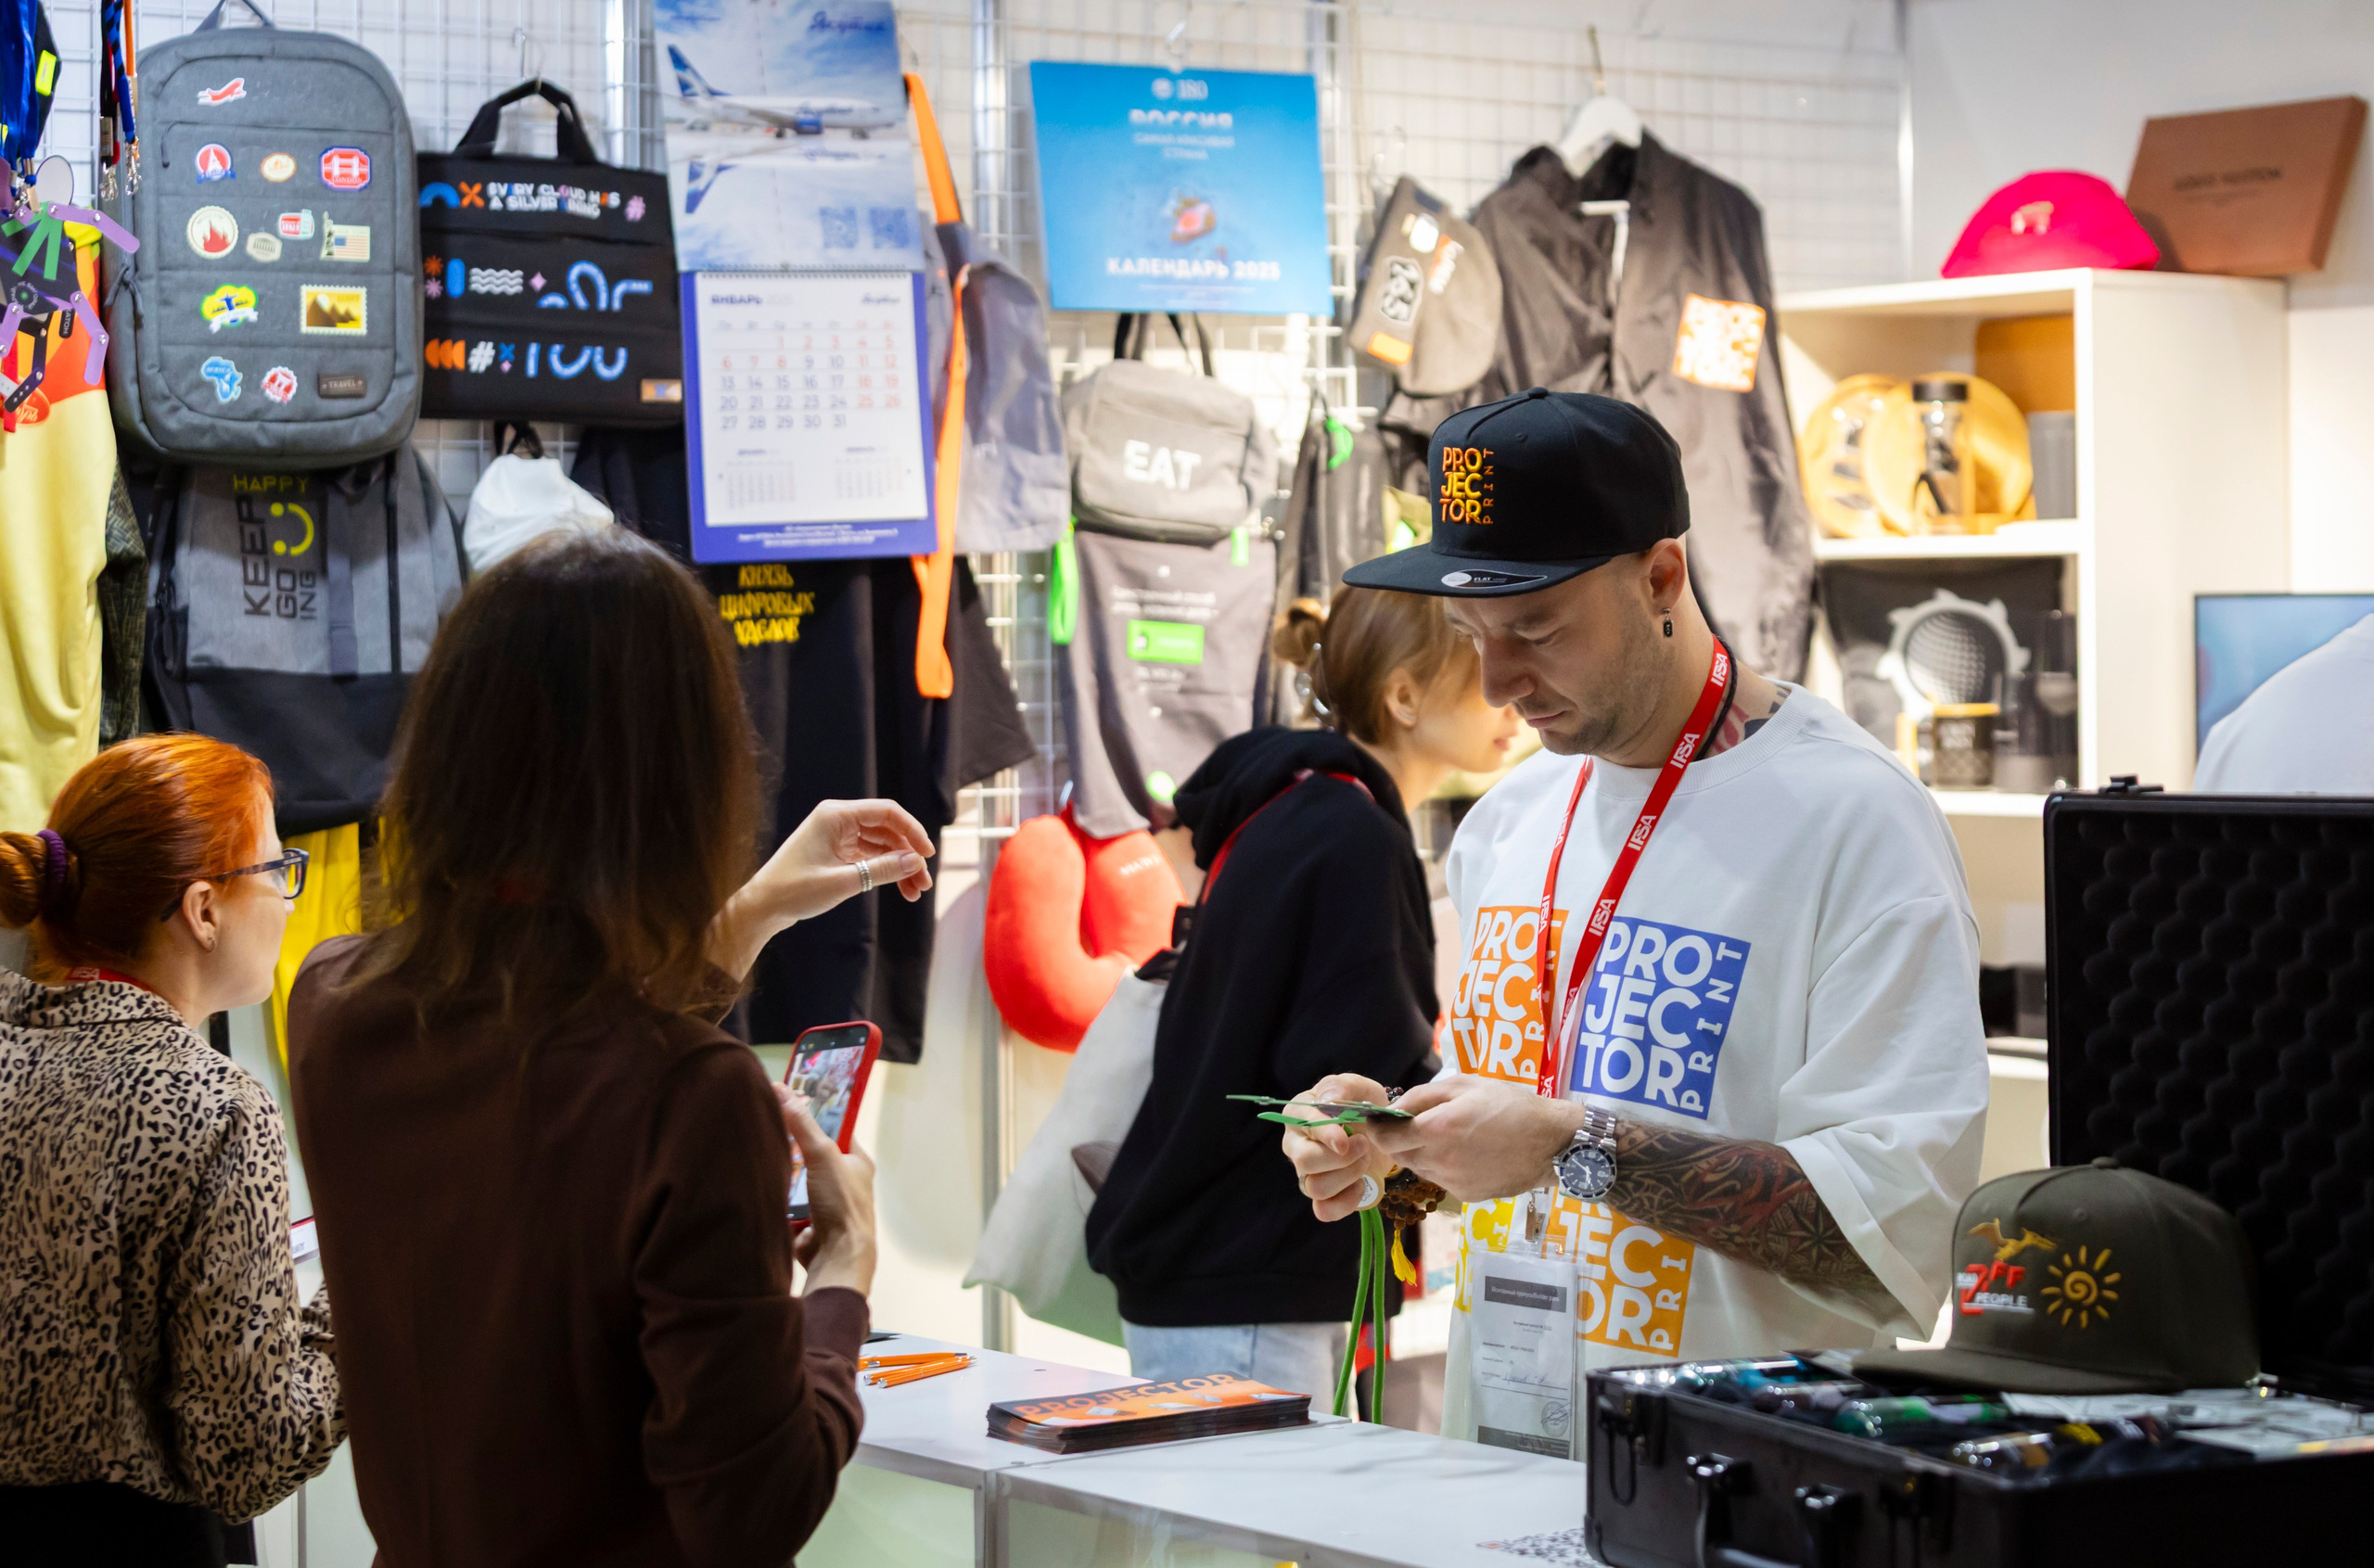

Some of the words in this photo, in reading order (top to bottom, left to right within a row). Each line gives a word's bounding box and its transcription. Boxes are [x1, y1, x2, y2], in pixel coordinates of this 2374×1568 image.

[489, 196, 504, 211] A
[505, 196, 558, 211] SILVER
[1106, 258, 1229, 279] КАЛЕНДАРЬ
[1232, 260, 1281, 281] 2025
[711, 294, 762, 305] ЯНВАРЬ
[805, 355, 814, 369] 9
[830, 355, 844, 369] 10
[328, 379, 357, 389] TRAVEL
[720, 396, 738, 410] 20
[775, 395, 792, 410] 22
[803, 394, 820, 409] 23
[721, 415, 738, 430] 27
[749, 415, 766, 429] 28
[776, 415, 793, 429] 29
[804, 414, 822, 428] 30
[1122, 440, 1202, 491] EAT
[1443, 447, 1482, 473] PRO
[234, 475, 308, 492] HAPPY
[1441, 472, 1483, 499] JEC
[1483, 448, 1494, 525] PRINT
[1439, 499, 1481, 525] TOR
[236, 494, 271, 616] KEEP
[1471, 911, 1539, 962] PRO
[1596, 921, 1713, 988] PRO
[1453, 960, 1535, 1021] JEC
[1585, 974, 1702, 1049] JEC
[1679, 941, 1742, 1112] PRINT
[1579, 1032, 1685, 1107] TOR
[1576, 1278, 1653, 1347] OR
[1974, 1292, 2028, 1307] PEOPLE
[1014, 1373, 1237, 1416] PROJECTOR
